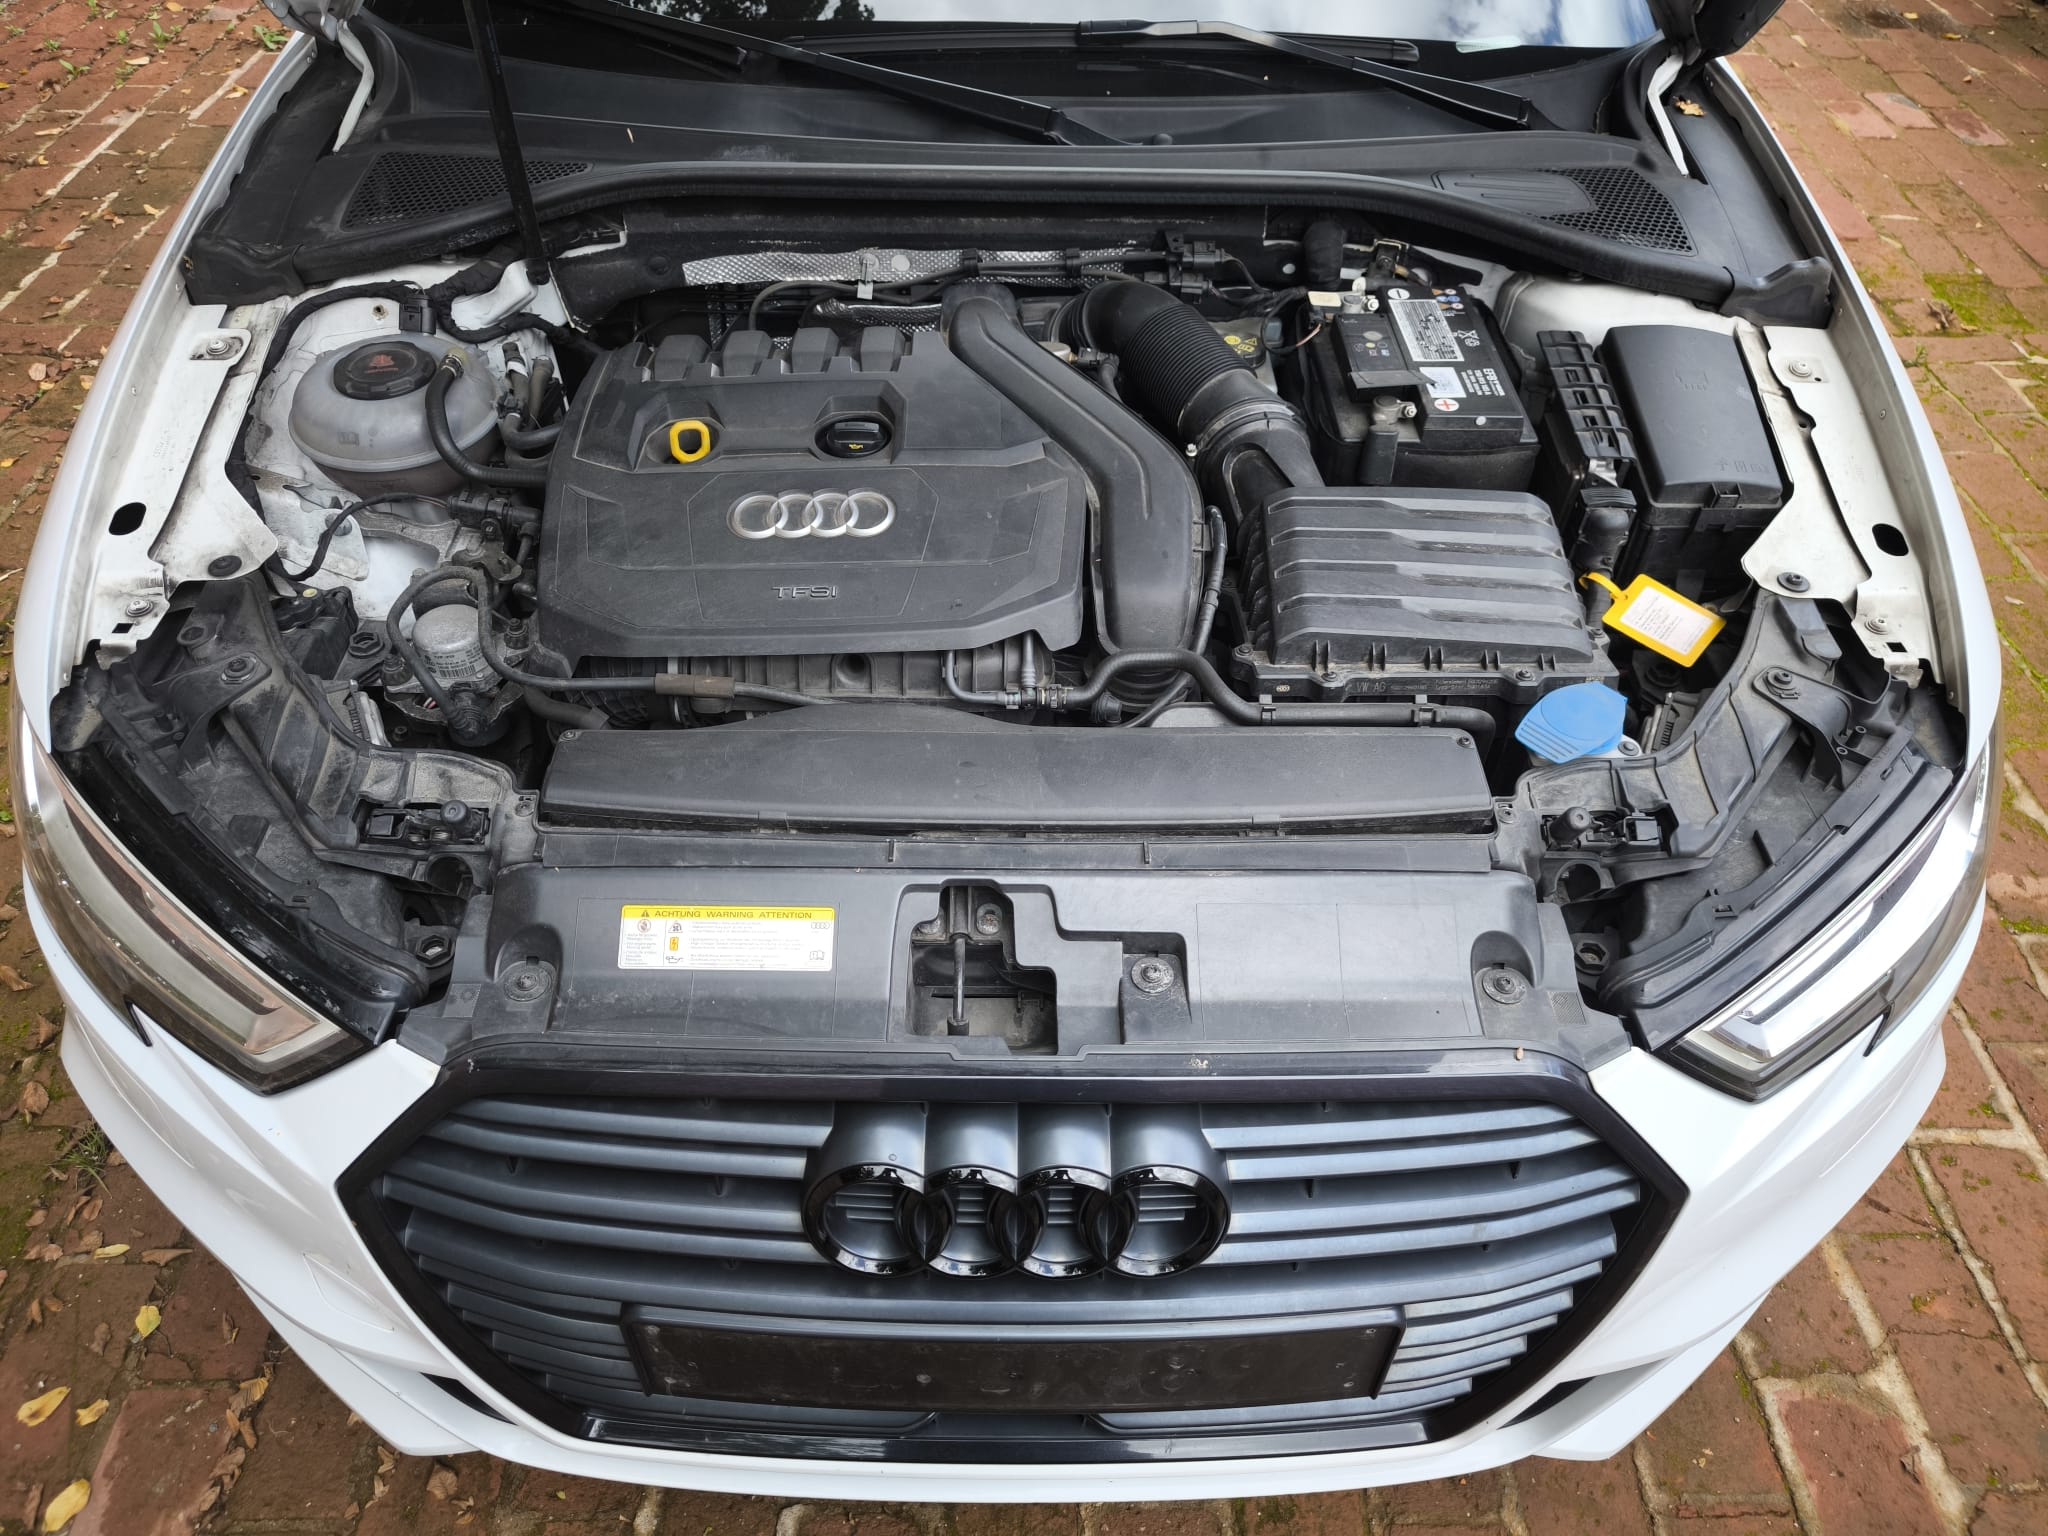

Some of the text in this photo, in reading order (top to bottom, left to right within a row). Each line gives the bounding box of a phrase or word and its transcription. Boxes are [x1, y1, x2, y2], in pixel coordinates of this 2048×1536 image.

[772, 585, 838, 599] TFSI
[654, 910, 812, 919] ACHTUNG WARNING ATTENTION
